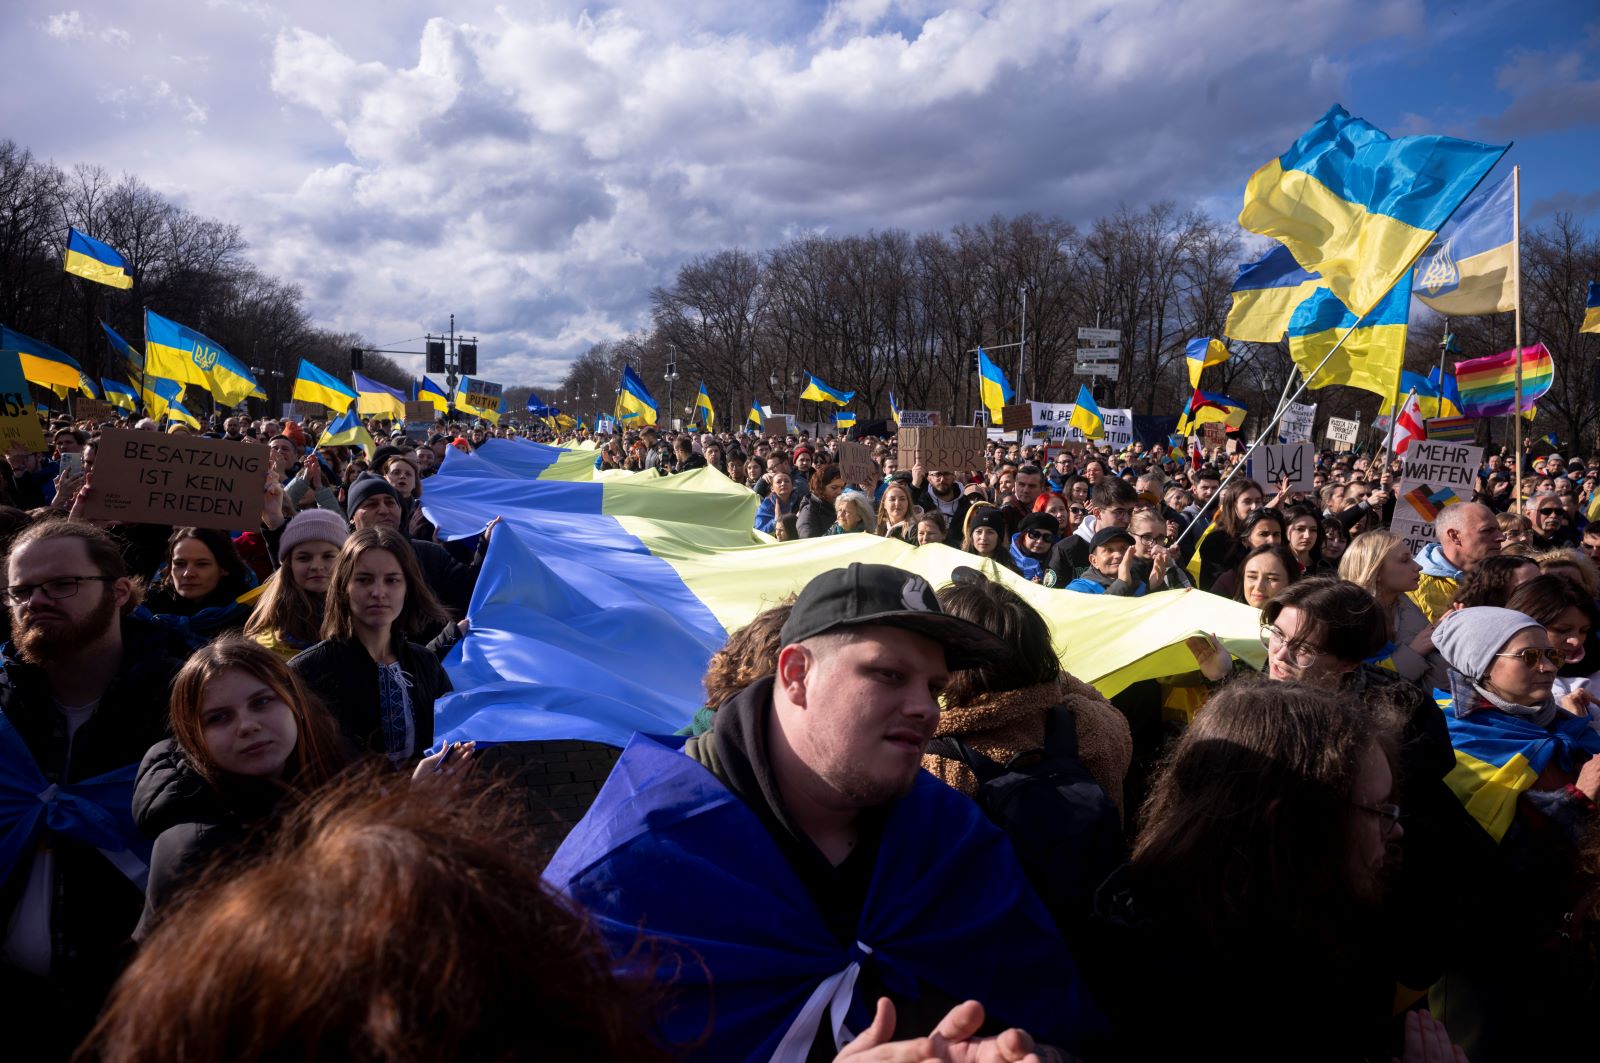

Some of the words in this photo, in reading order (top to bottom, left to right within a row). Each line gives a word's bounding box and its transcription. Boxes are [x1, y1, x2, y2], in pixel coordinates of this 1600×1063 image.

[470, 394, 498, 409] PUTIN
[1040, 410, 1053, 420] NO
[1331, 419, 1346, 427] RUSSIA
[1333, 426, 1353, 435] TERRORIST
[1335, 433, 1348, 441] STATE
[123, 441, 260, 473] BESATZUNG
[902, 449, 977, 468] TERROR
[1416, 444, 1470, 463] MEHR
[139, 468, 173, 486] IST
[185, 474, 234, 493] KEIN
[1405, 462, 1473, 484] WAFFEN
[148, 491, 243, 517] FRIEDEN
